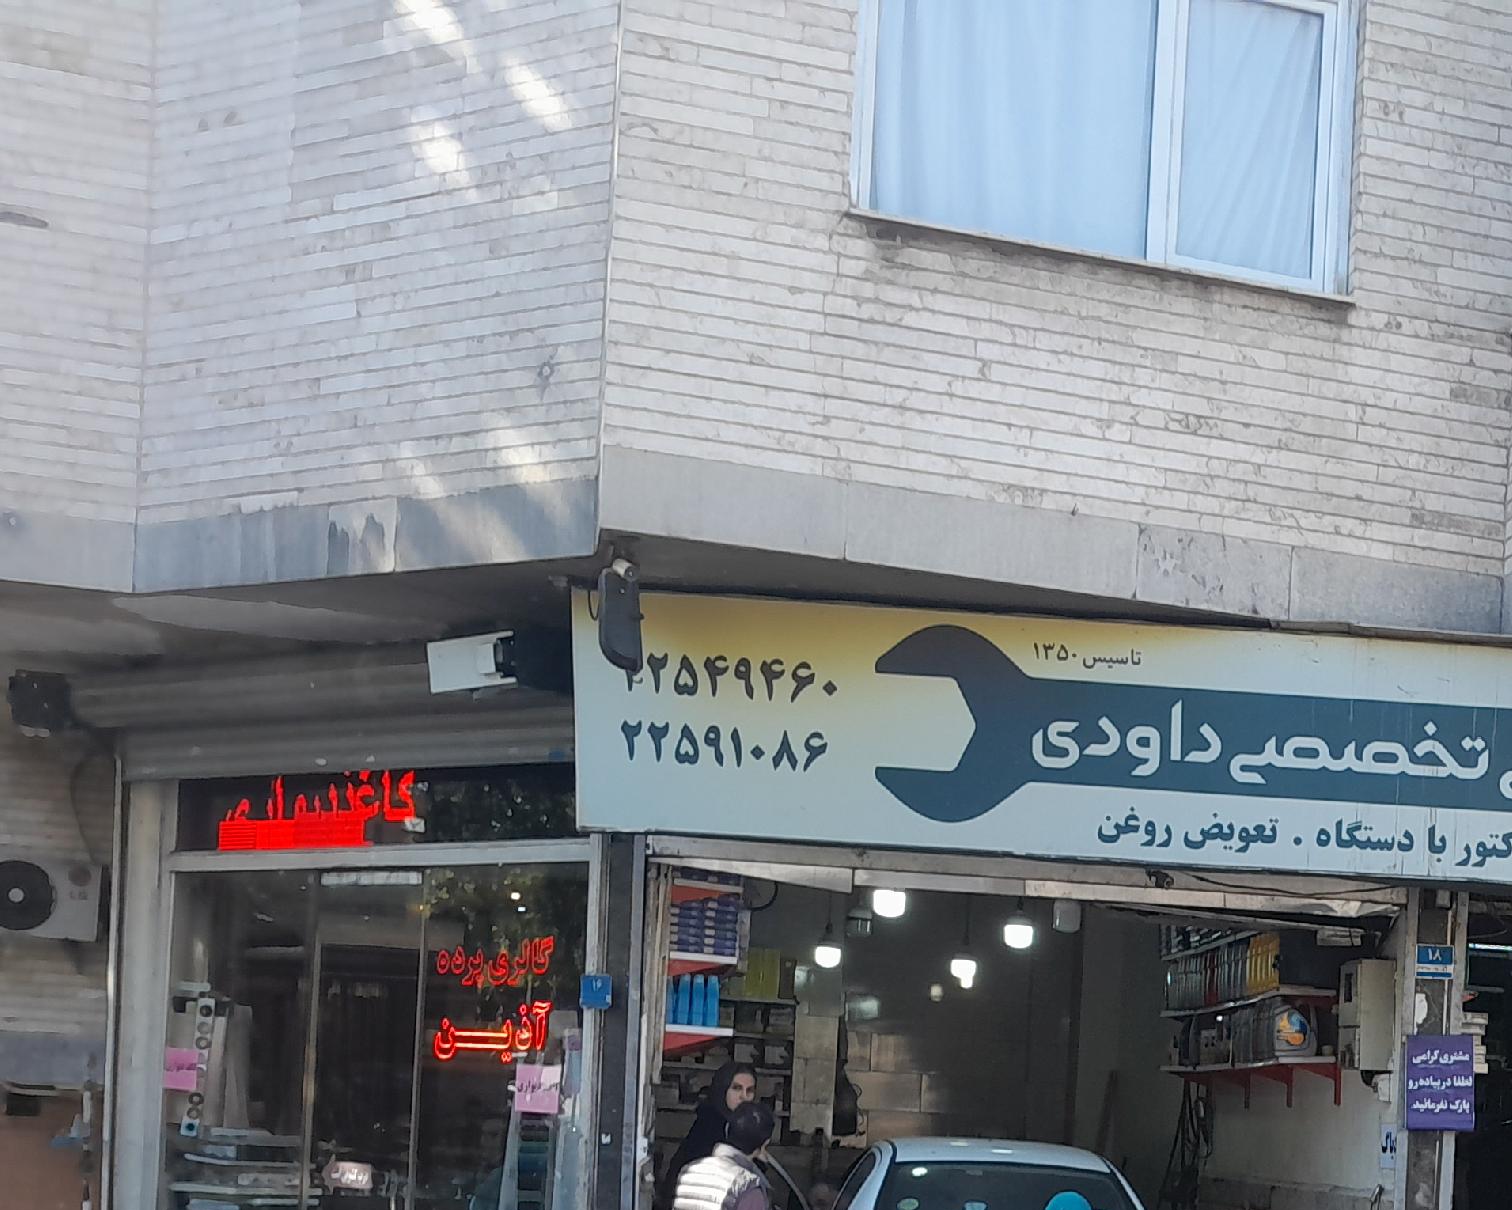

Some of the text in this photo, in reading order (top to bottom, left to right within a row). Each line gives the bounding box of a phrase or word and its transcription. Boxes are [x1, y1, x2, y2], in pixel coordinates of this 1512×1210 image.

[1032, 641, 1142, 669] تاسیس ۱۳۵۰
[620, 719, 829, 773] ۲۲۵۹۱۰۸۶
[1030, 699, 1223, 778] داودی
[1228, 720, 1490, 785] تخصصی
[1097, 805, 1173, 848] روغن
[1183, 811, 1280, 855] تعویض
[1315, 818, 1415, 854] دستگاه
[1426, 824, 1447, 862] با
[436, 935, 555, 988] گالری پرده
[433, 999, 554, 1063] آذین
